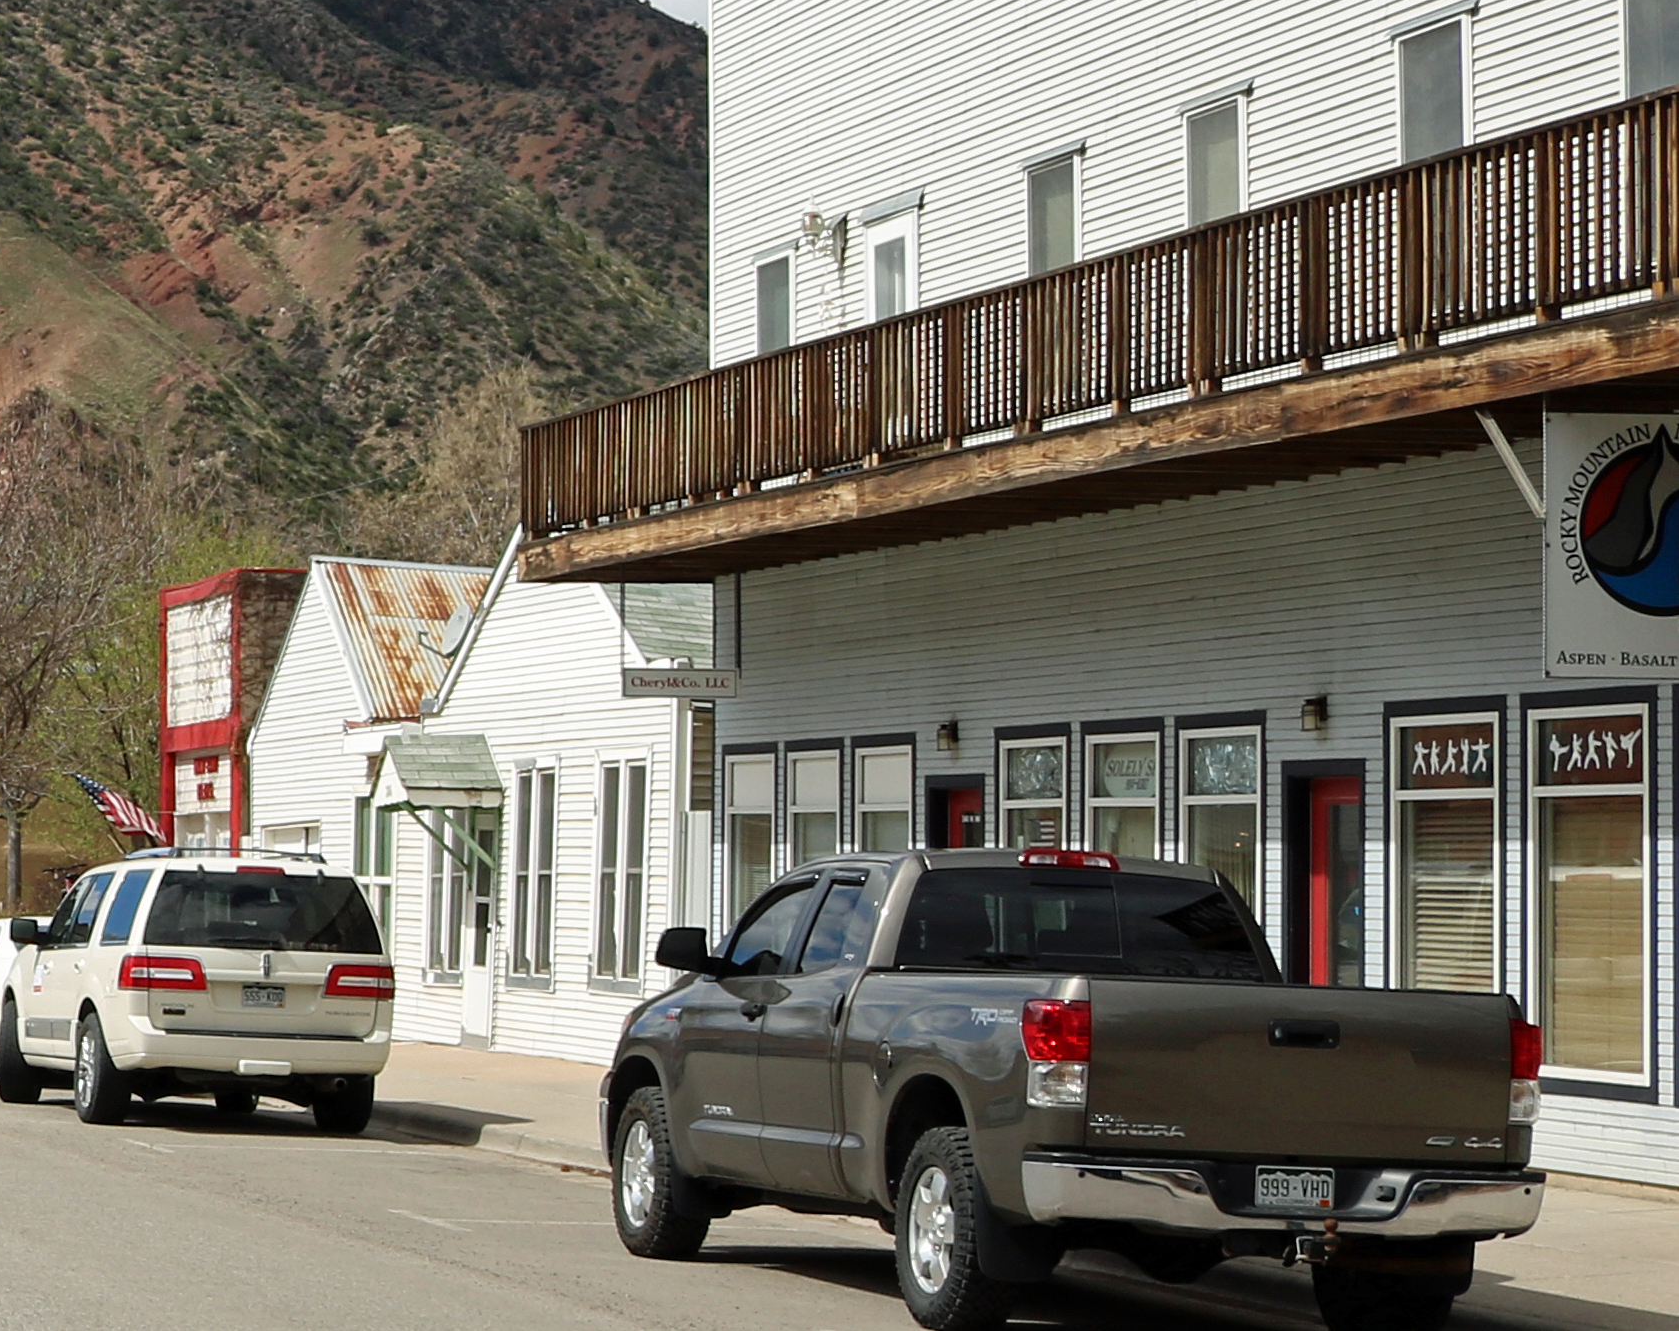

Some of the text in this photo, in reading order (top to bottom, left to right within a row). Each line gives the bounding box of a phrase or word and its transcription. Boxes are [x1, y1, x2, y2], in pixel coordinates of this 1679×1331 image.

[1559, 423, 1651, 585] ROCKY MOUNTAIN
[631, 676, 730, 689] Cheryl&Co. LLC
[970, 1008, 998, 1026] TRD
